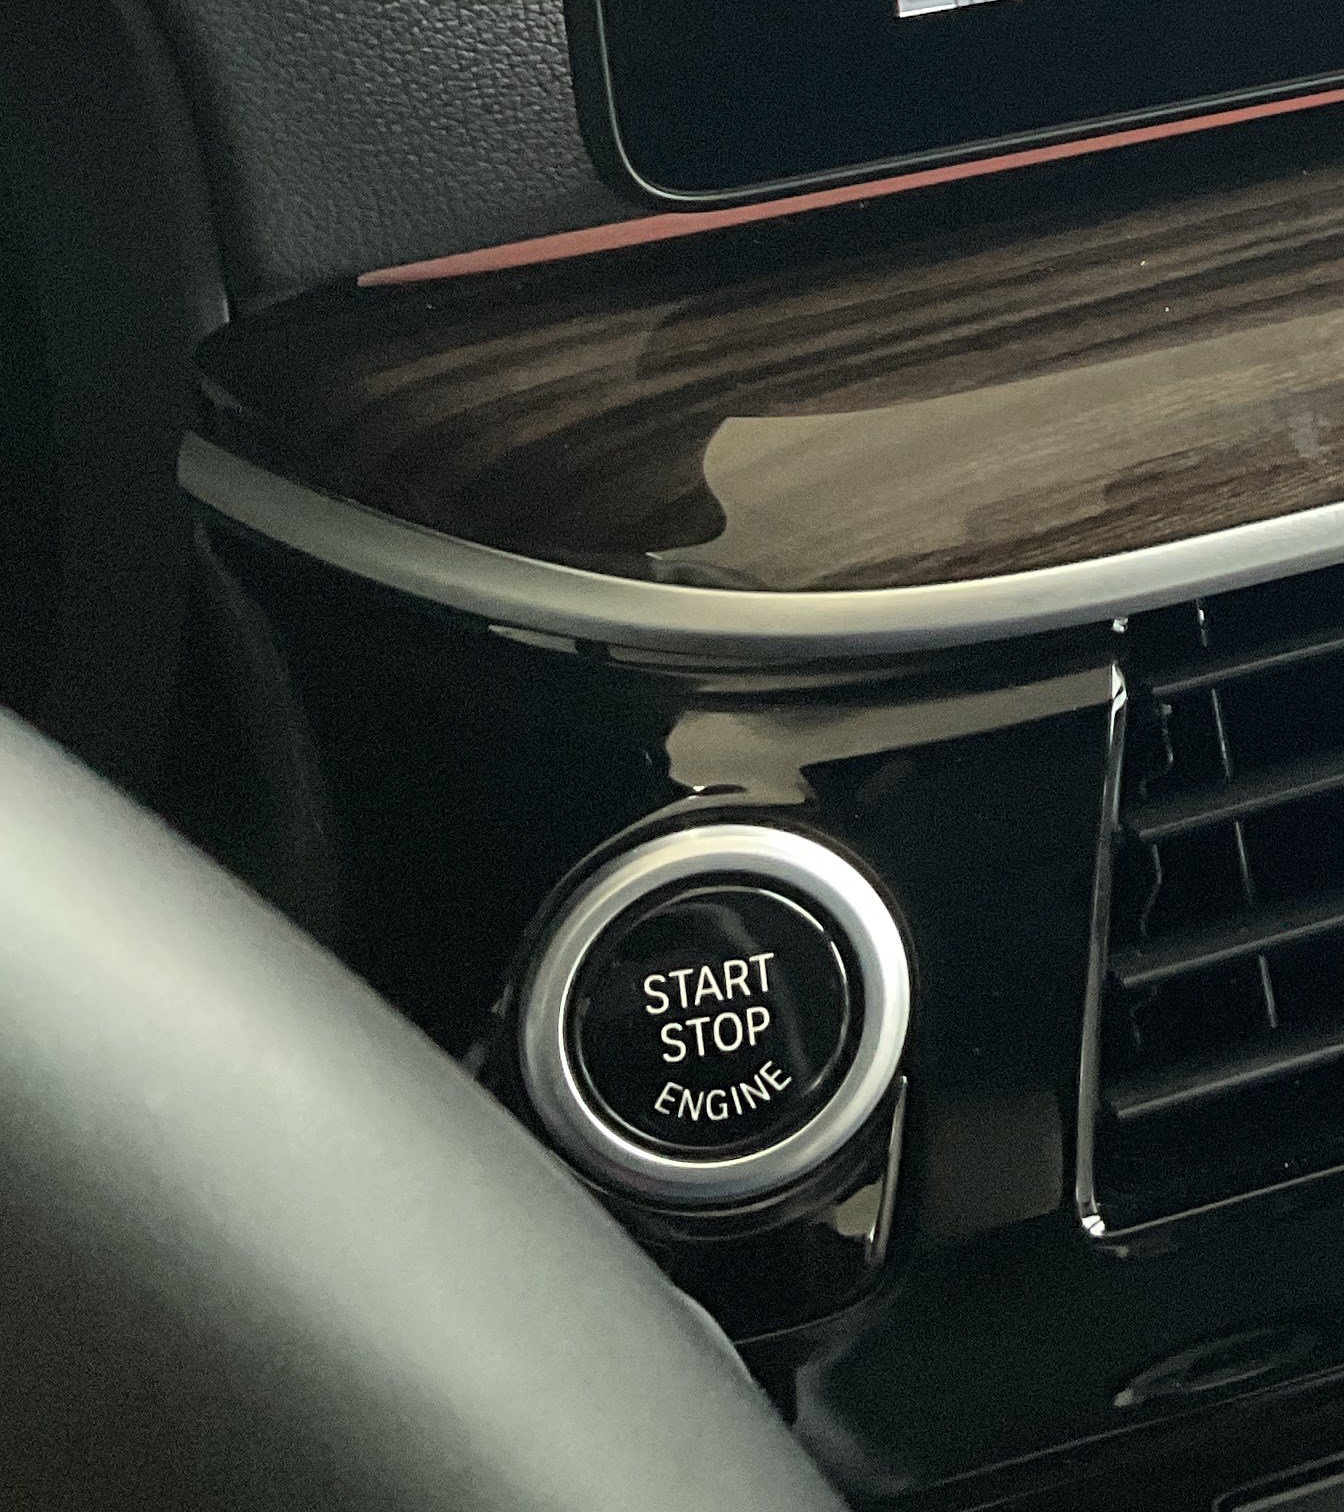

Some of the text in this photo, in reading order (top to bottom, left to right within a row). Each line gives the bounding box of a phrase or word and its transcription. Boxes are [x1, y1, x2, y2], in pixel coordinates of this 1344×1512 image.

[643, 951, 776, 1016] START
[659, 1005, 772, 1063] STOP
[653, 1059, 793, 1122] ENGINE
